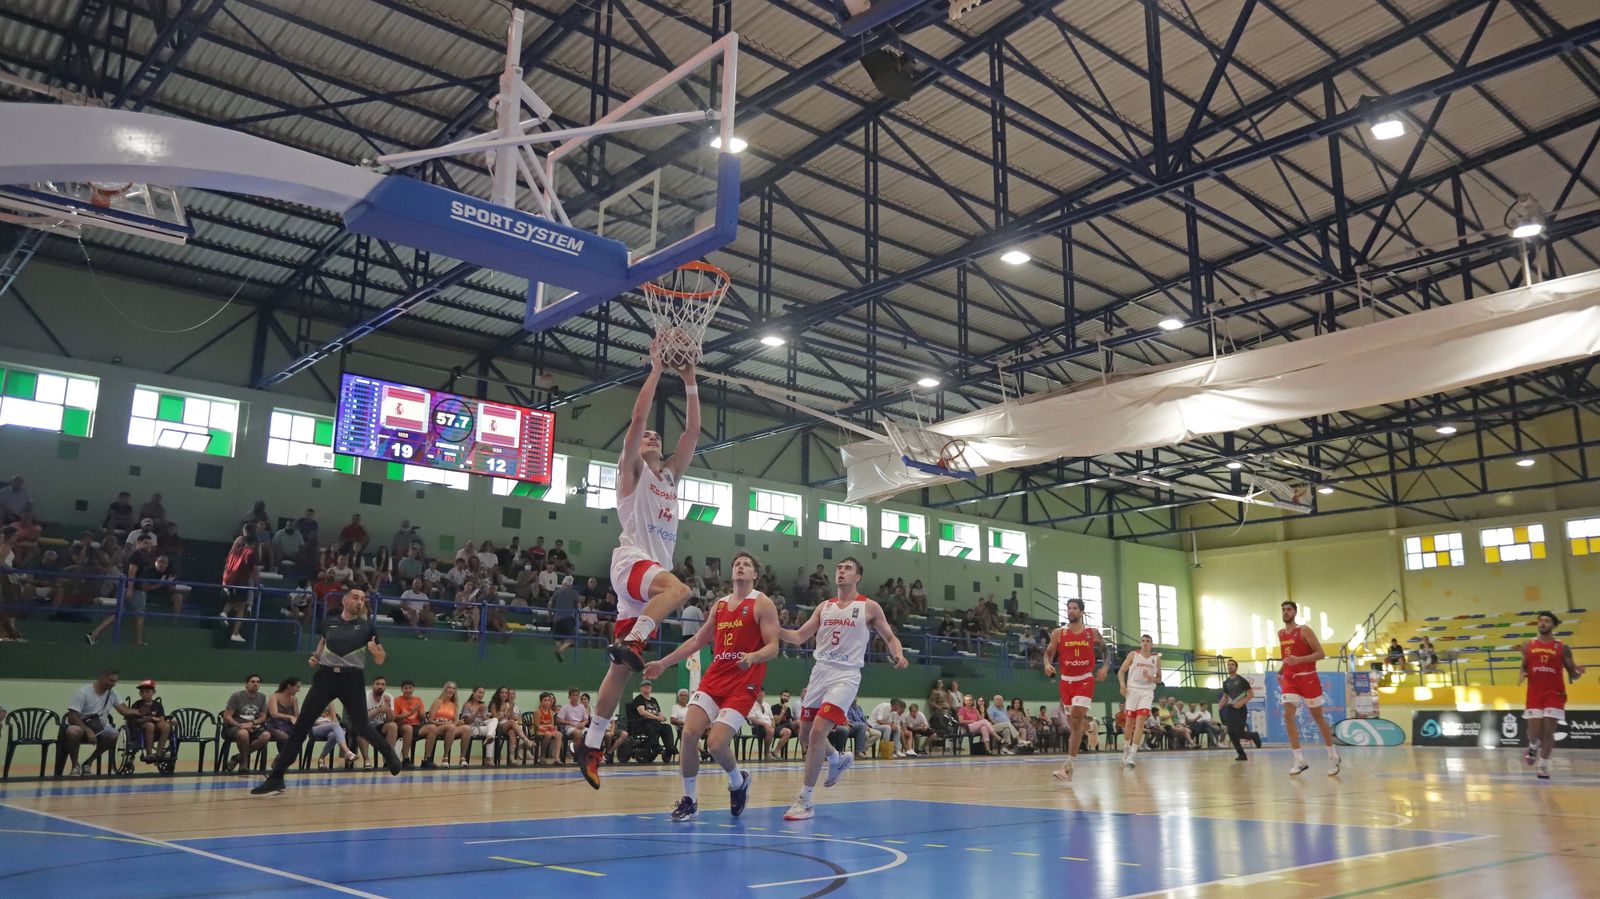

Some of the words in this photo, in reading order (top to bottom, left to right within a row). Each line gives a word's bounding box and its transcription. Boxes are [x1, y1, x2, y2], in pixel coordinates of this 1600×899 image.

[451, 200, 513, 231] SPORT
[513, 220, 585, 252] SYSTEM
[435, 412, 470, 429] 57.7
[391, 443, 413, 458] 19
[486, 457, 506, 472] 12
[658, 507, 672, 521] 14
[717, 619, 743, 630] ESPAÑA
[824, 618, 856, 627] ESPAÑA
[723, 633, 733, 646] 12
[831, 631, 841, 646] 5
[1074, 648, 1080, 657] 11
[1540, 655, 1549, 663] 17
[1142, 669, 1148, 677] 8
